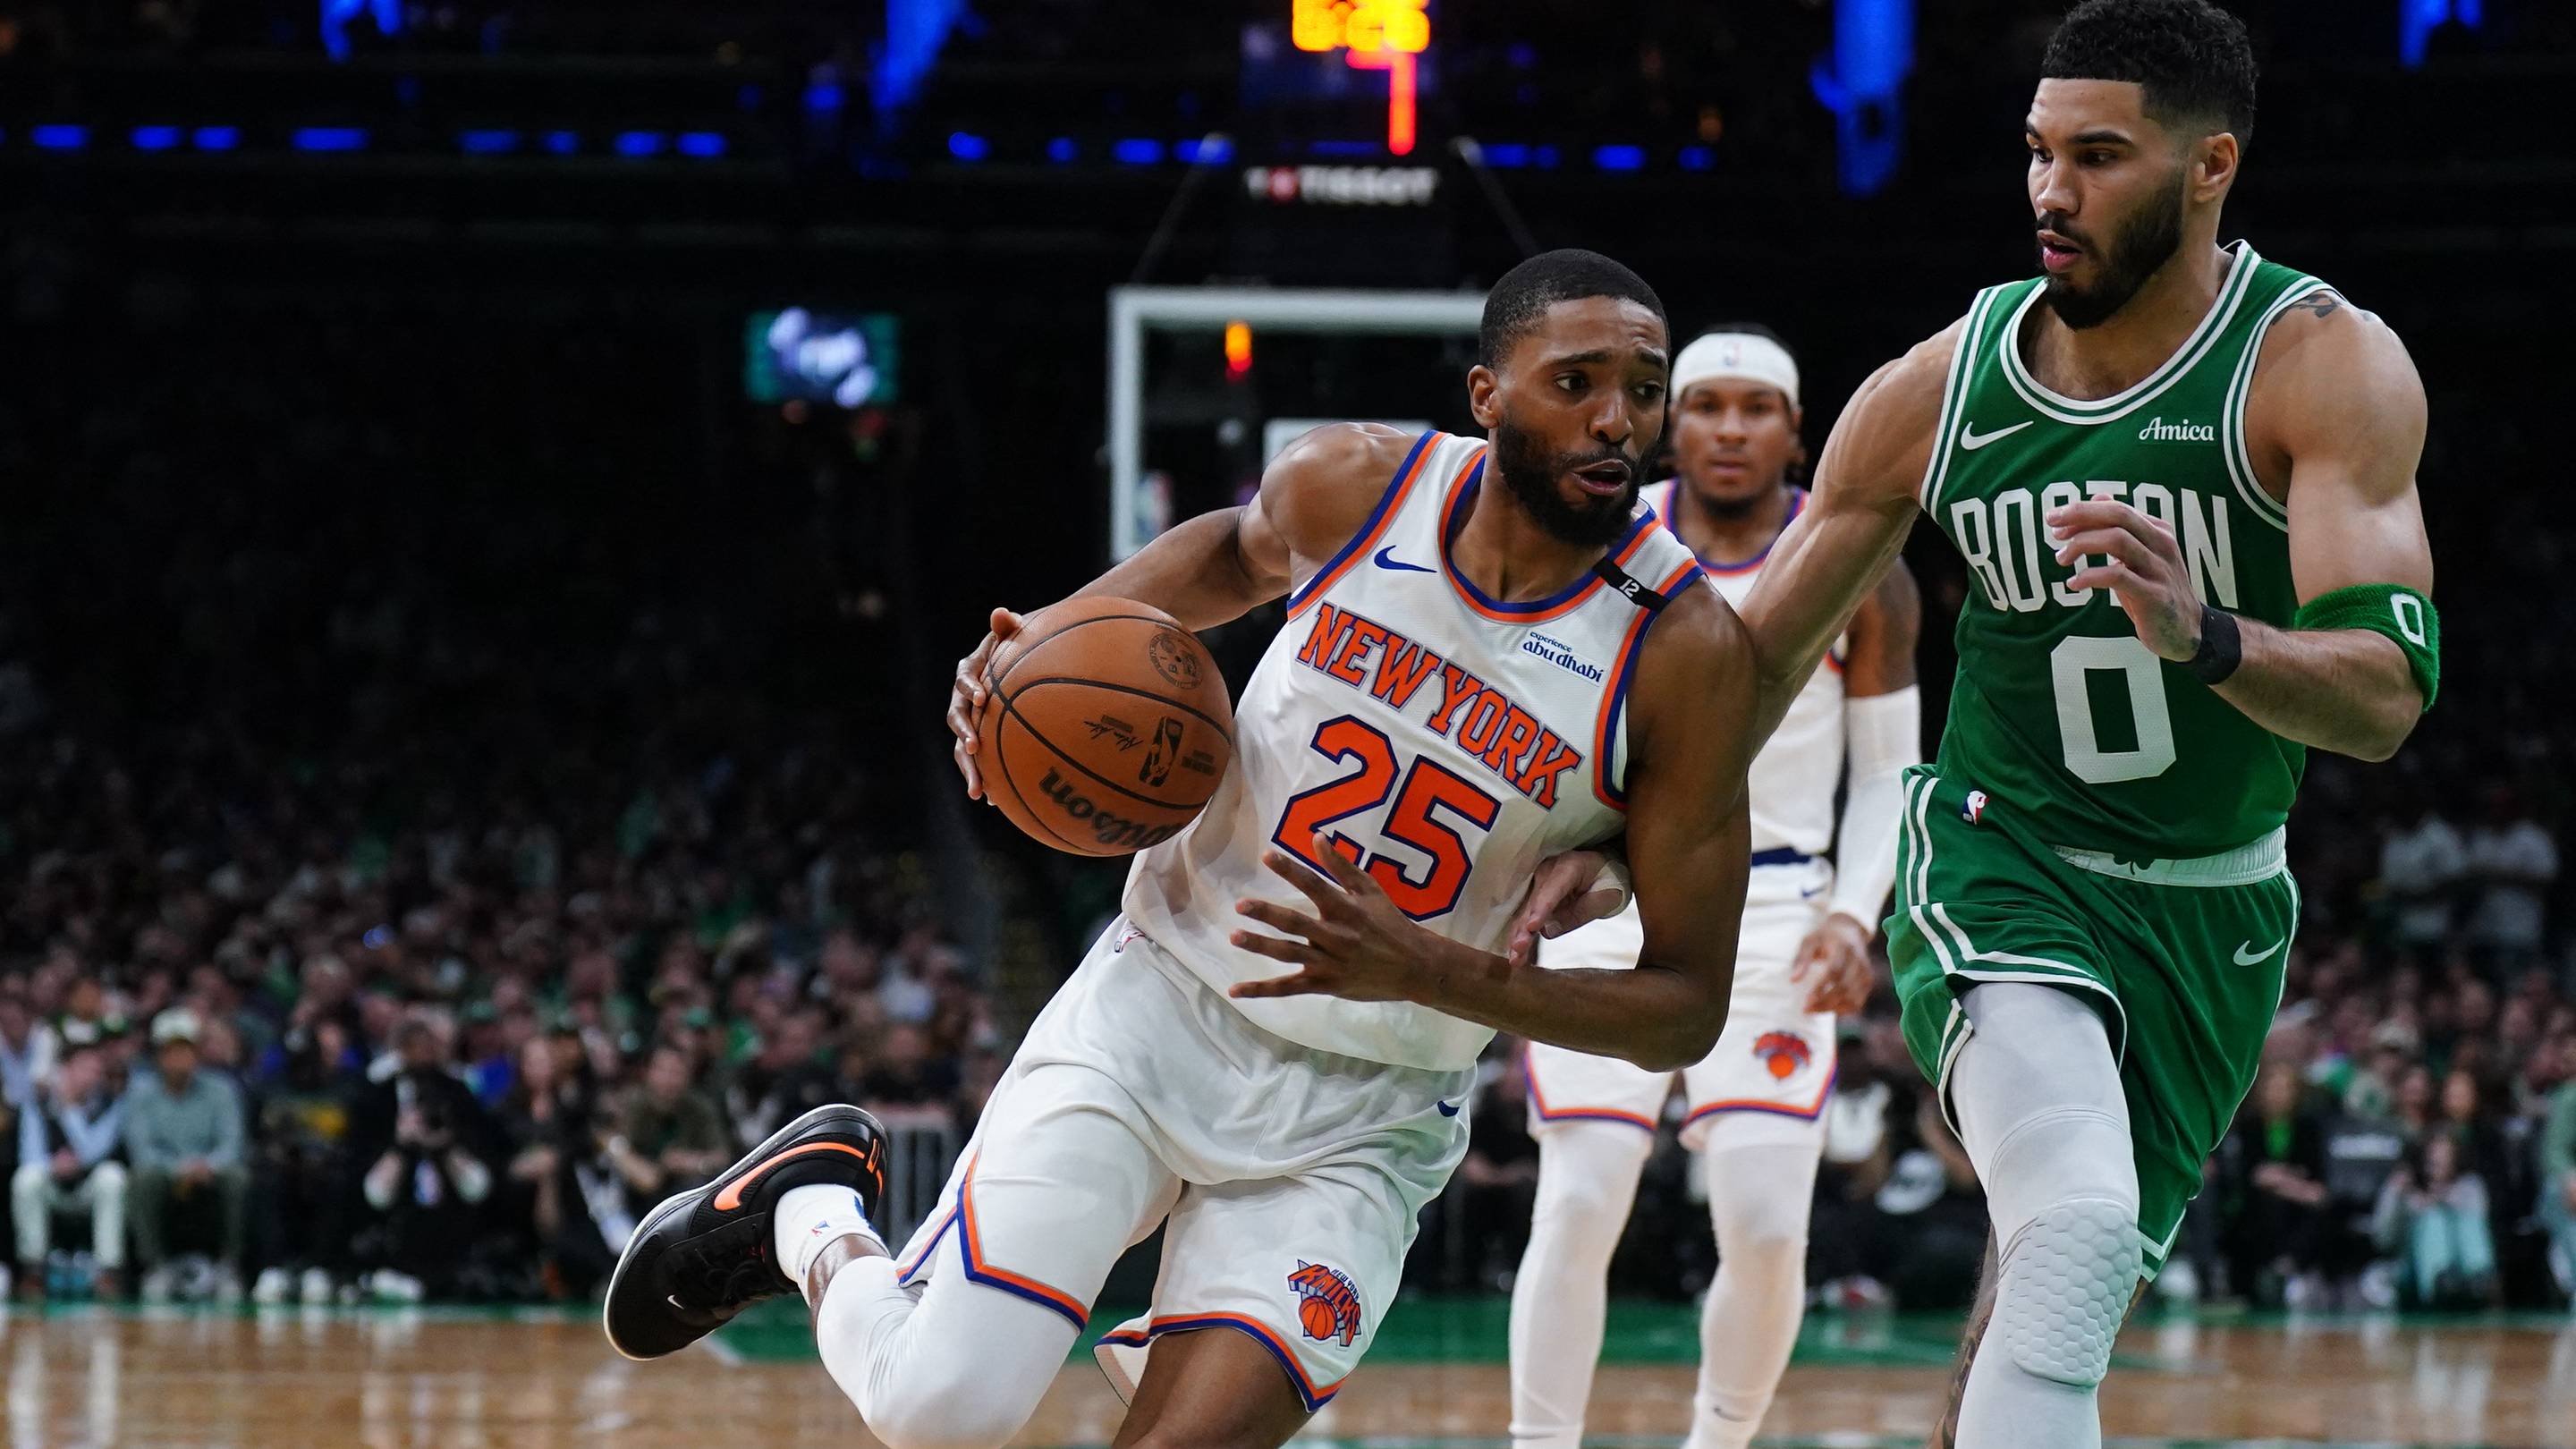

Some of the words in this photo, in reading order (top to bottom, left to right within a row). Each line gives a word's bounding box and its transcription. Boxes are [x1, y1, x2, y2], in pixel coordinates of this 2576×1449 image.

[2139, 416, 2214, 441] Amica
[1619, 579, 1640, 597] 12
[1530, 631, 1572, 652] experience
[1523, 641, 1555, 661] abu
[1555, 654, 1604, 682] dhabi
[1297, 601, 1440, 711] NEW
[1425, 660, 1584, 811] YORK
[2051, 636, 2176, 784] 0
[1271, 714, 1502, 922] 25
[1331, 1268, 1348, 1282] NEW
